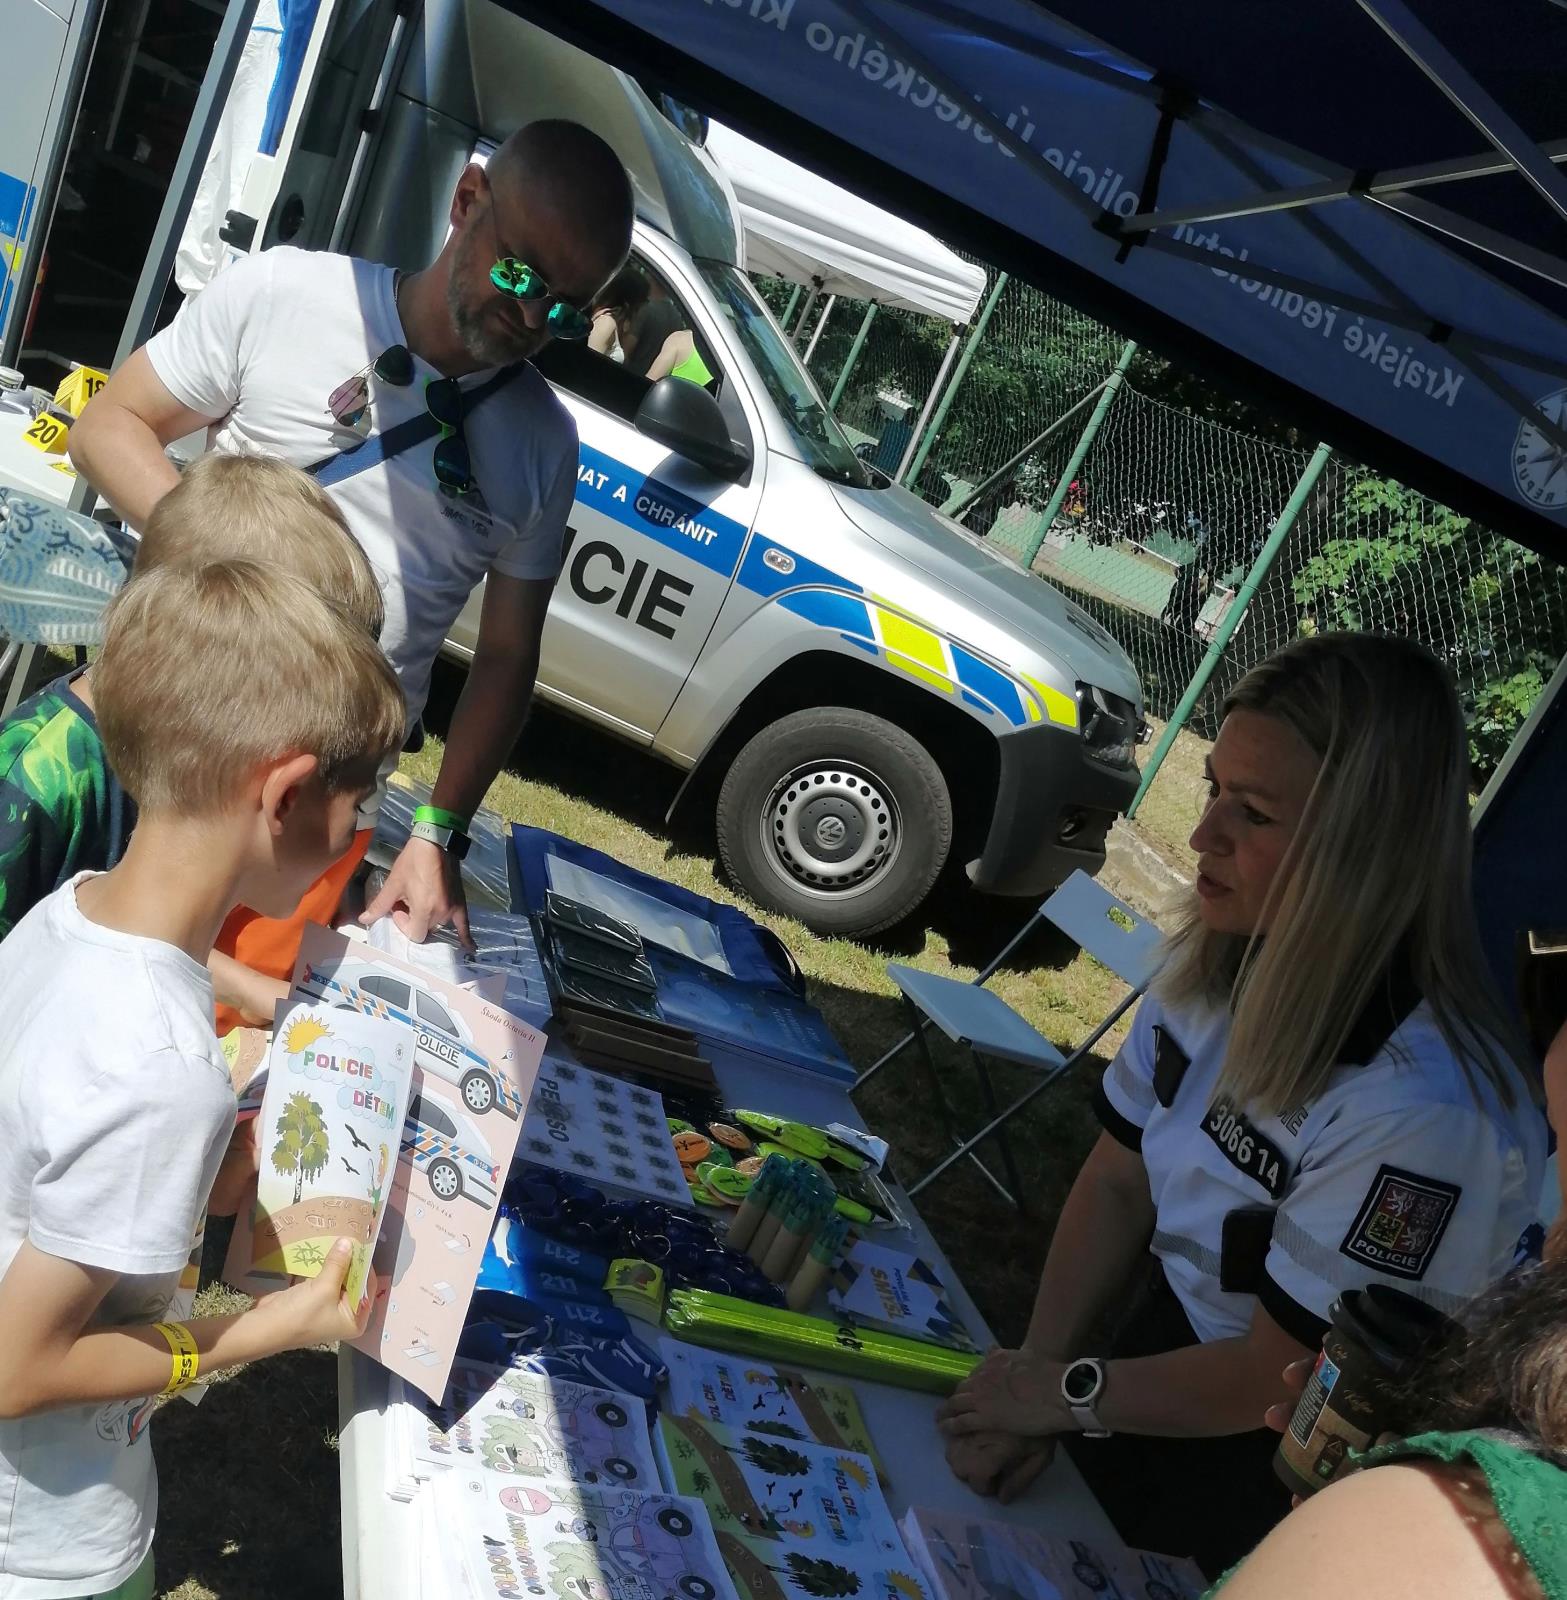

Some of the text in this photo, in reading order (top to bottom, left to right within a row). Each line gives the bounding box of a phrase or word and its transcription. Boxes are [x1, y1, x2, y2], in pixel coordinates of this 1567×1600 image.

[27, 418, 59, 444] 20
[612, 485, 628, 503] A
[635, 496, 718, 546] CHRÁNIT
[480, 1006, 501, 1023] Škoda
[503, 1020, 528, 1040] Octavia
[303, 1050, 373, 1080] POLICIE
[352, 1089, 395, 1122] DĚTEM
[539, 1077, 570, 1142] PESO
[1355, 1239, 1418, 1268] POLICIE
[702, 1383, 724, 1424] POLICIE
[832, 1467, 860, 1518] POLICIE
[482, 1534, 524, 1600] POLDOVY
[505, 1512, 546, 1596] OMALOVÁNKY
